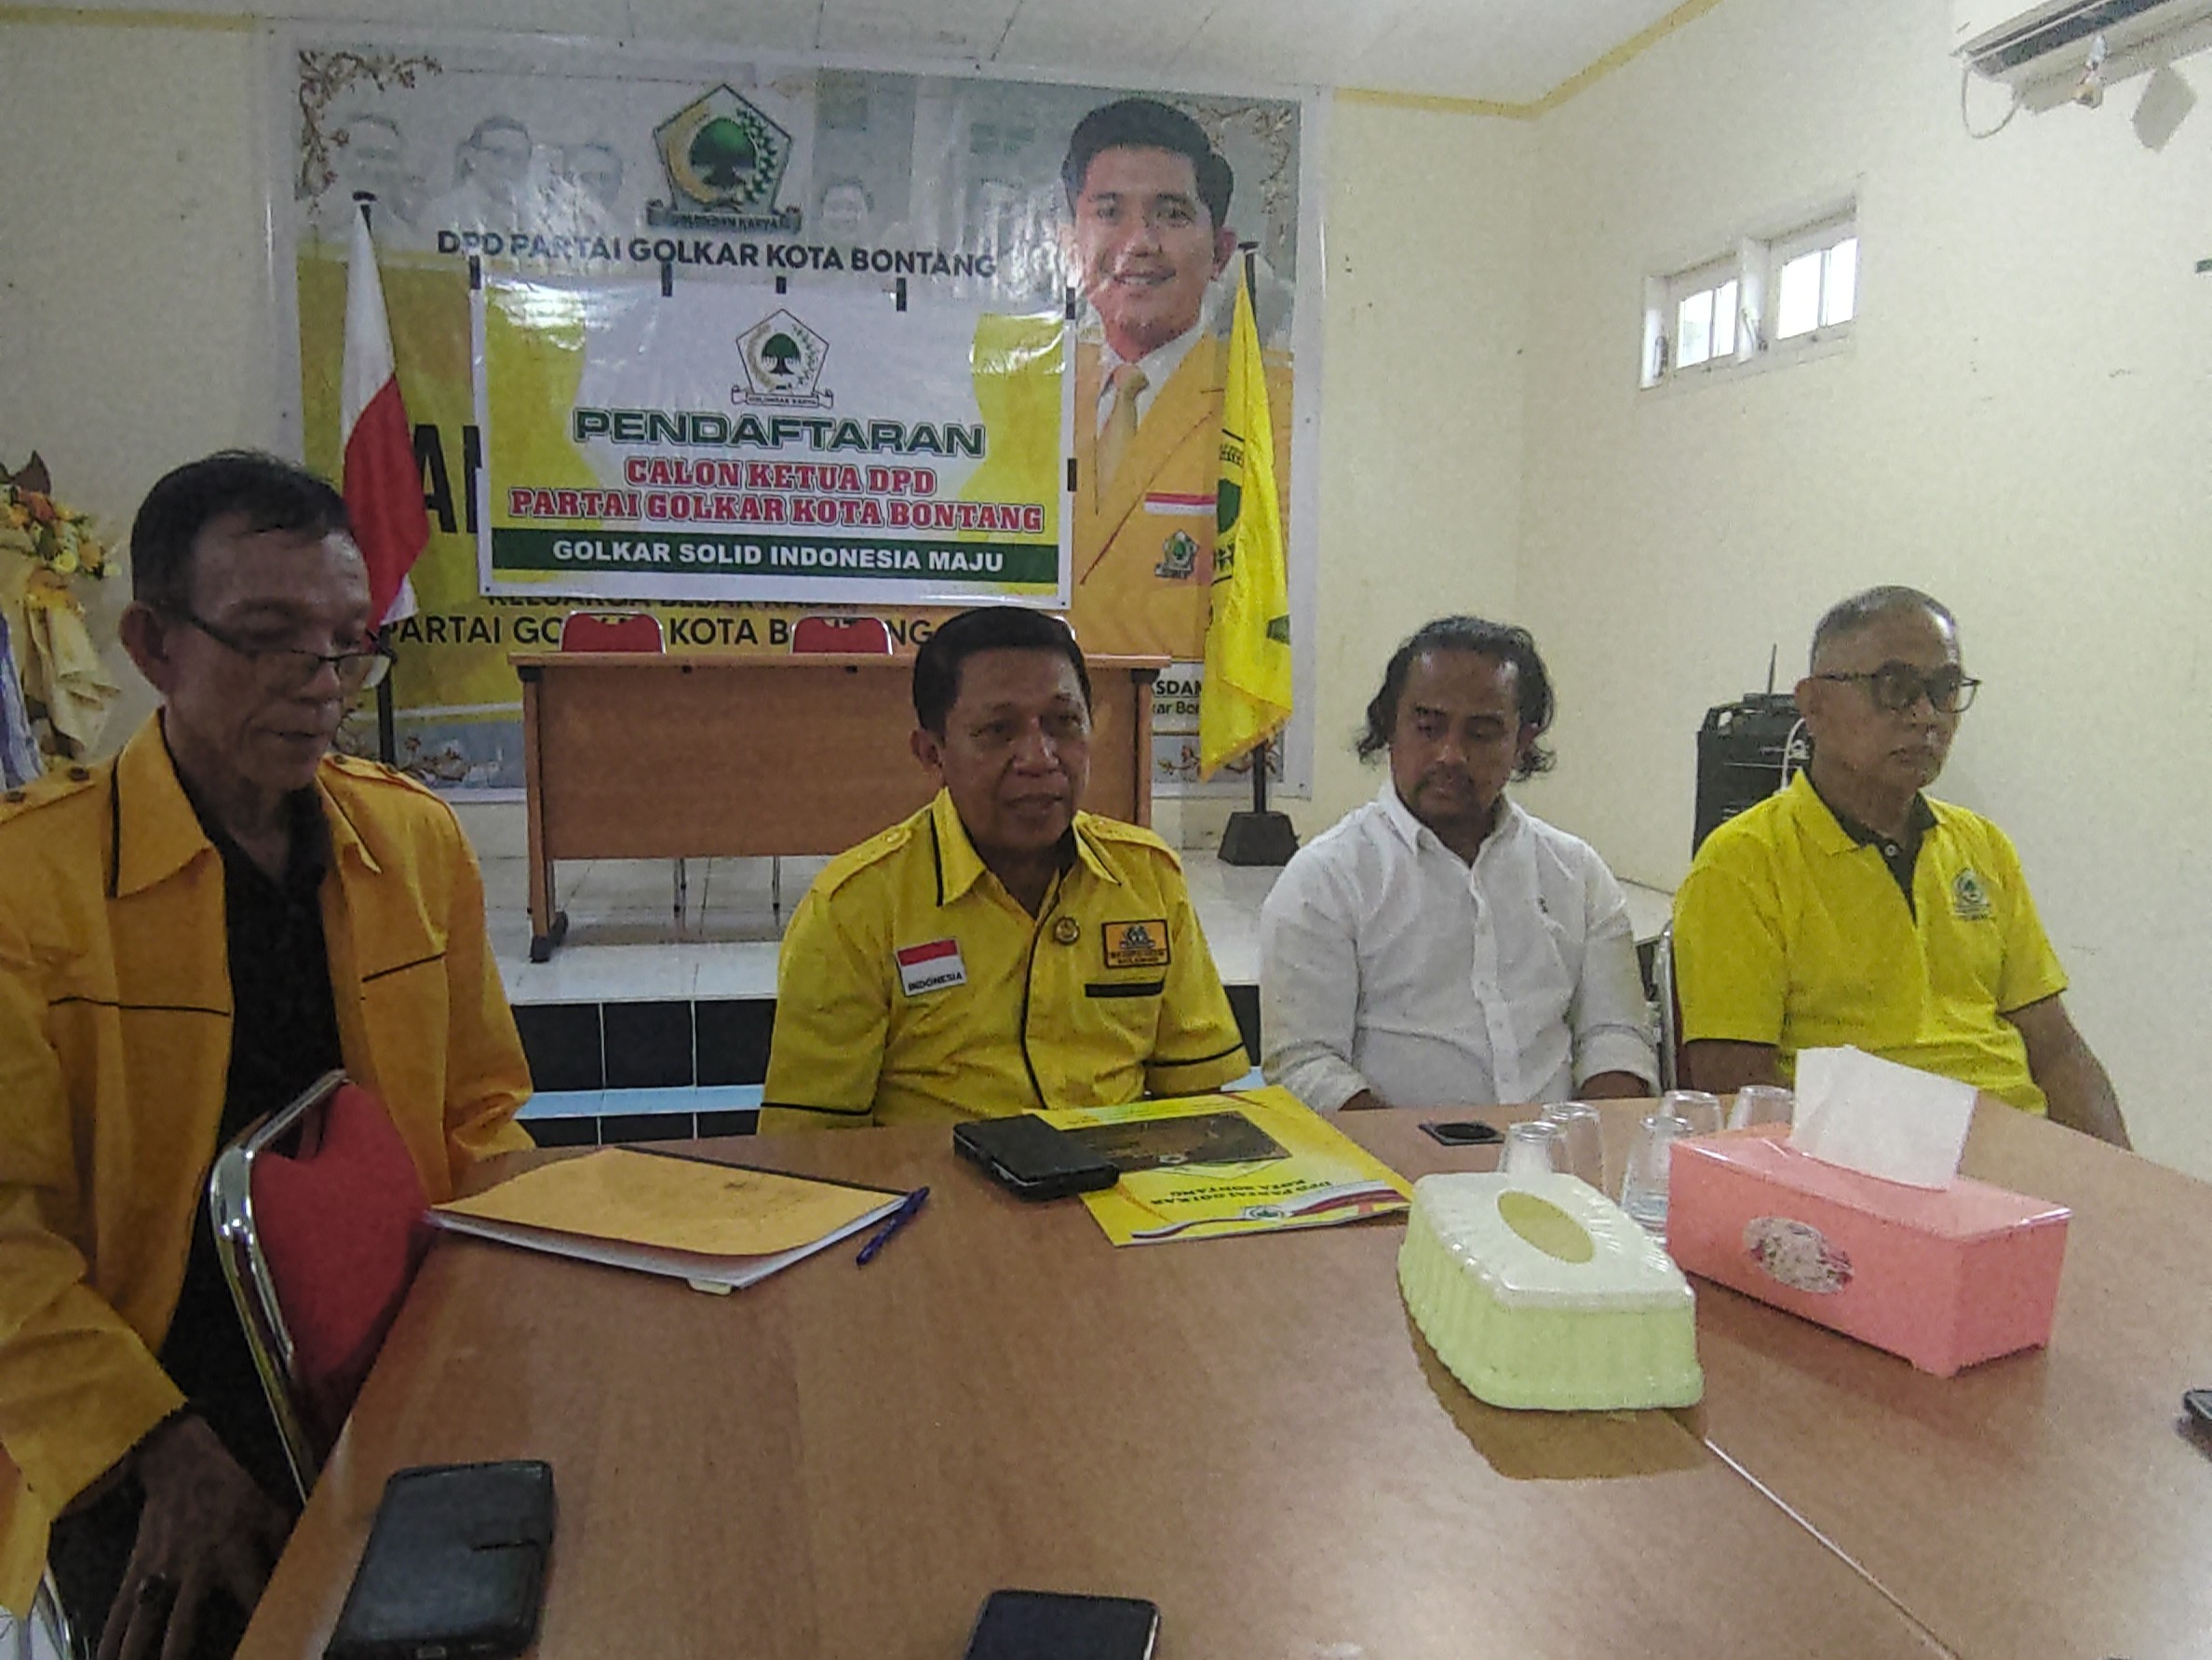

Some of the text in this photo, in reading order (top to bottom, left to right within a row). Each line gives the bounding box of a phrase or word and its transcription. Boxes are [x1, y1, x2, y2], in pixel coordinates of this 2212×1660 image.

[438, 231, 997, 277] DPD PARTAI GOLKAR KOTA BONTANG
[573, 408, 986, 458] PENDAFTARAN
[625, 456, 937, 497] CALON KETUA DPD
[508, 487, 1045, 533] PARTAI GOLKAR KOTA BONTANG
[552, 540, 1004, 573] GOLKAR SOLID INDONESIA MAJU
[669, 617, 758, 645] KOTA
[909, 972, 963, 992] INDONESIA
